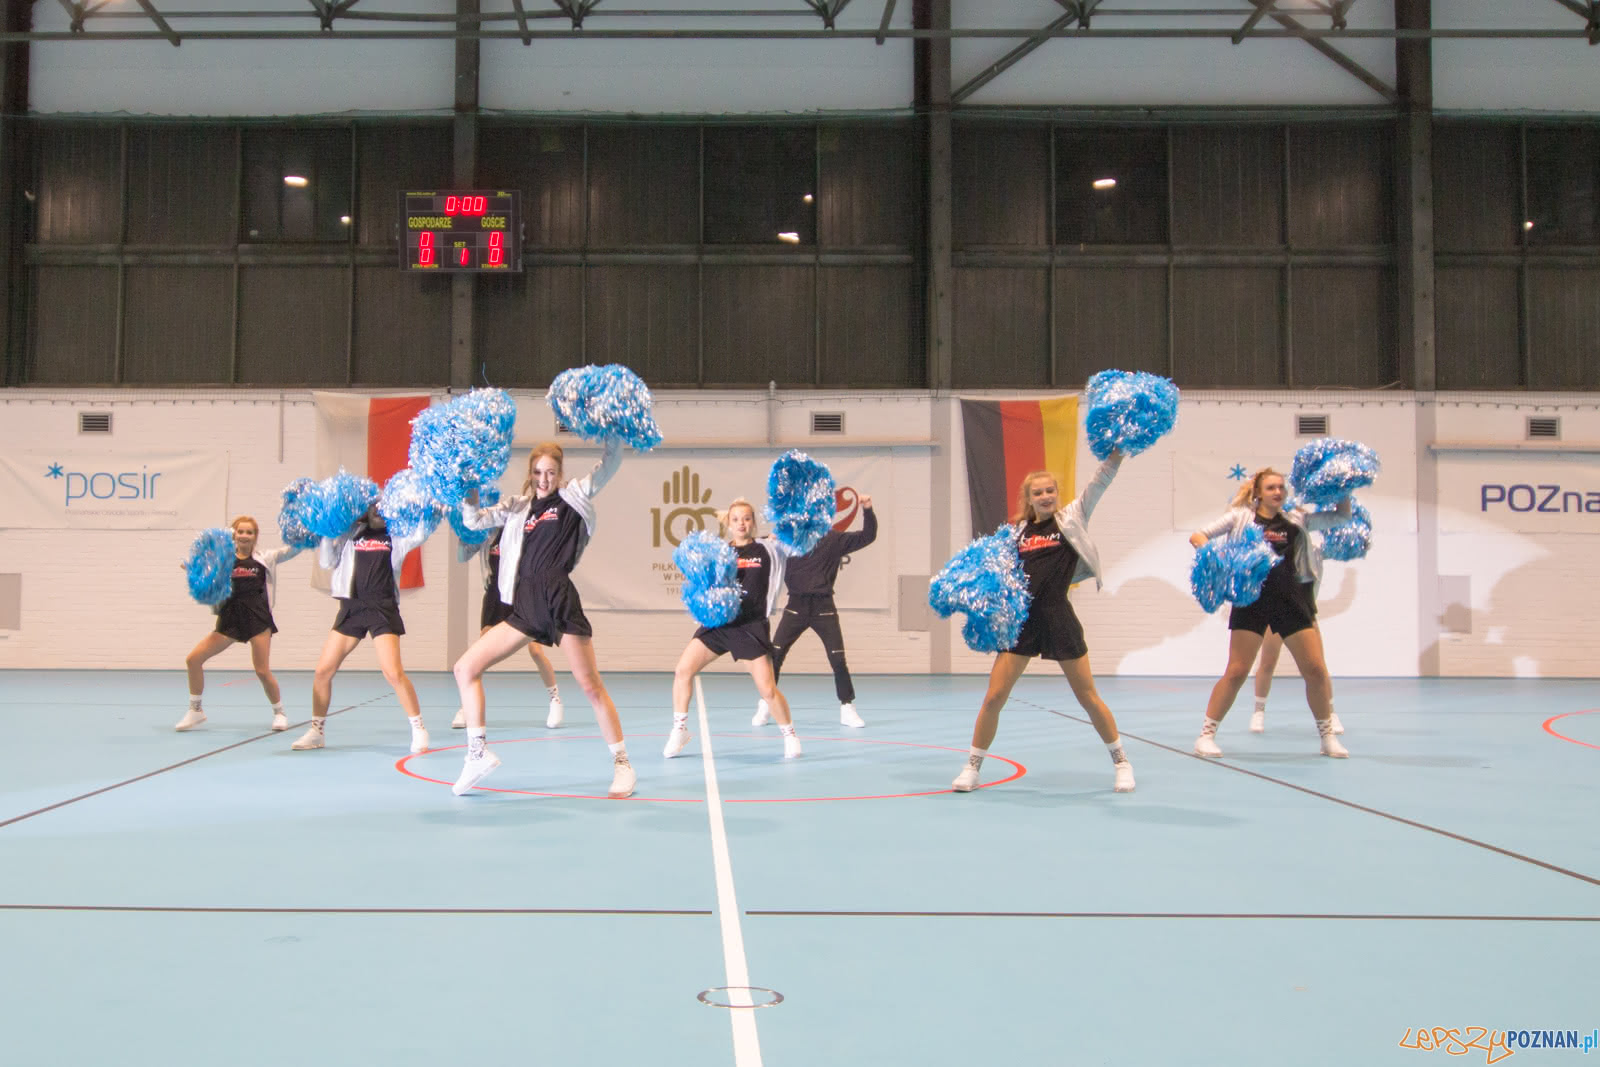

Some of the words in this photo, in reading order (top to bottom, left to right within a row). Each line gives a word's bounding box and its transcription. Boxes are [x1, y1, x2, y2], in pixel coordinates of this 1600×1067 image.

[446, 196, 485, 213] 0:00
[408, 216, 452, 228] GOSPODARZE
[66, 465, 162, 507] posir
[663, 573, 673, 581] W
